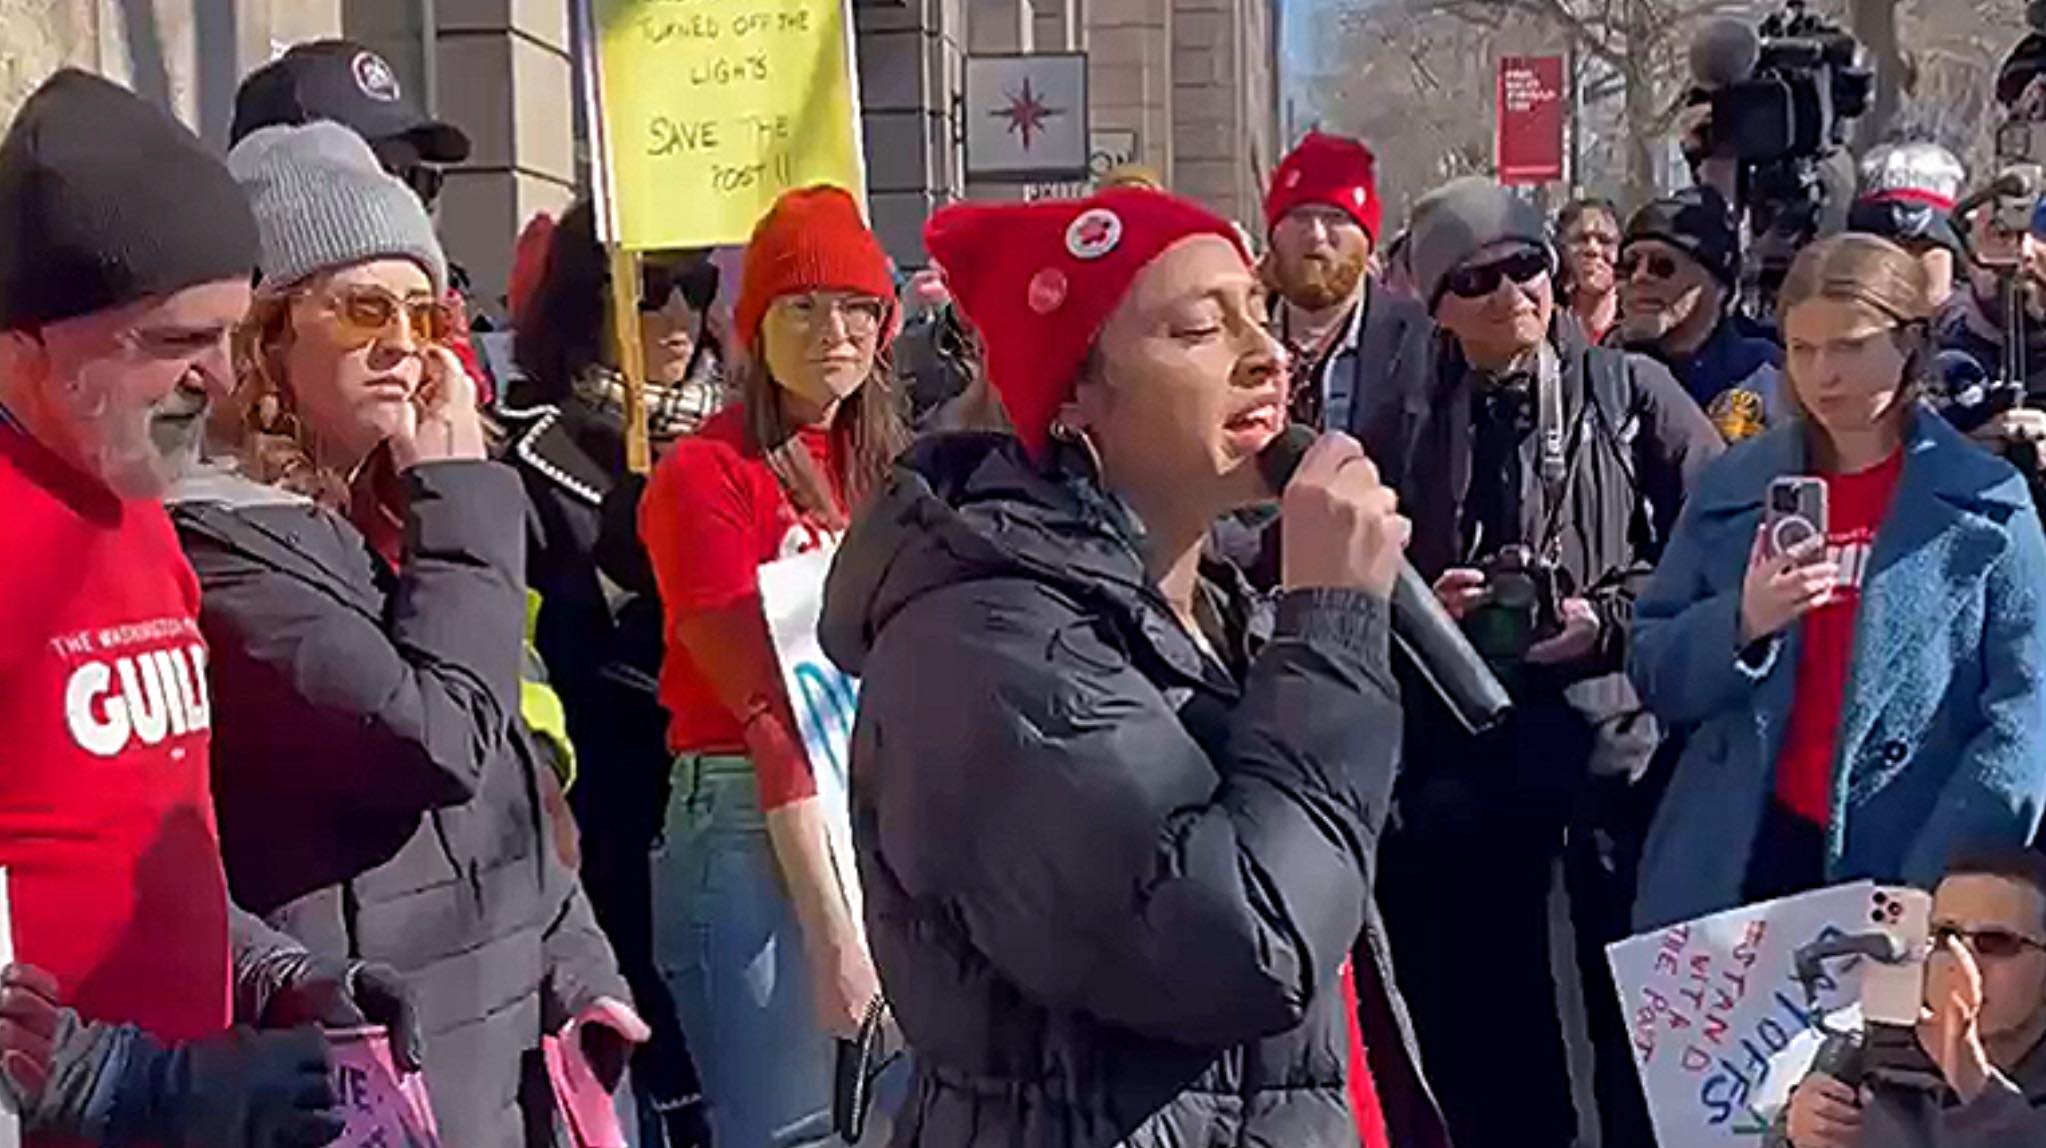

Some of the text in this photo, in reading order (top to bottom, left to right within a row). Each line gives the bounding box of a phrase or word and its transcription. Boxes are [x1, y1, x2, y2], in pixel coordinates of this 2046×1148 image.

[646, 114, 789, 156] SAVE THE
[711, 162, 767, 191] POST
[50, 630, 94, 661] THE
